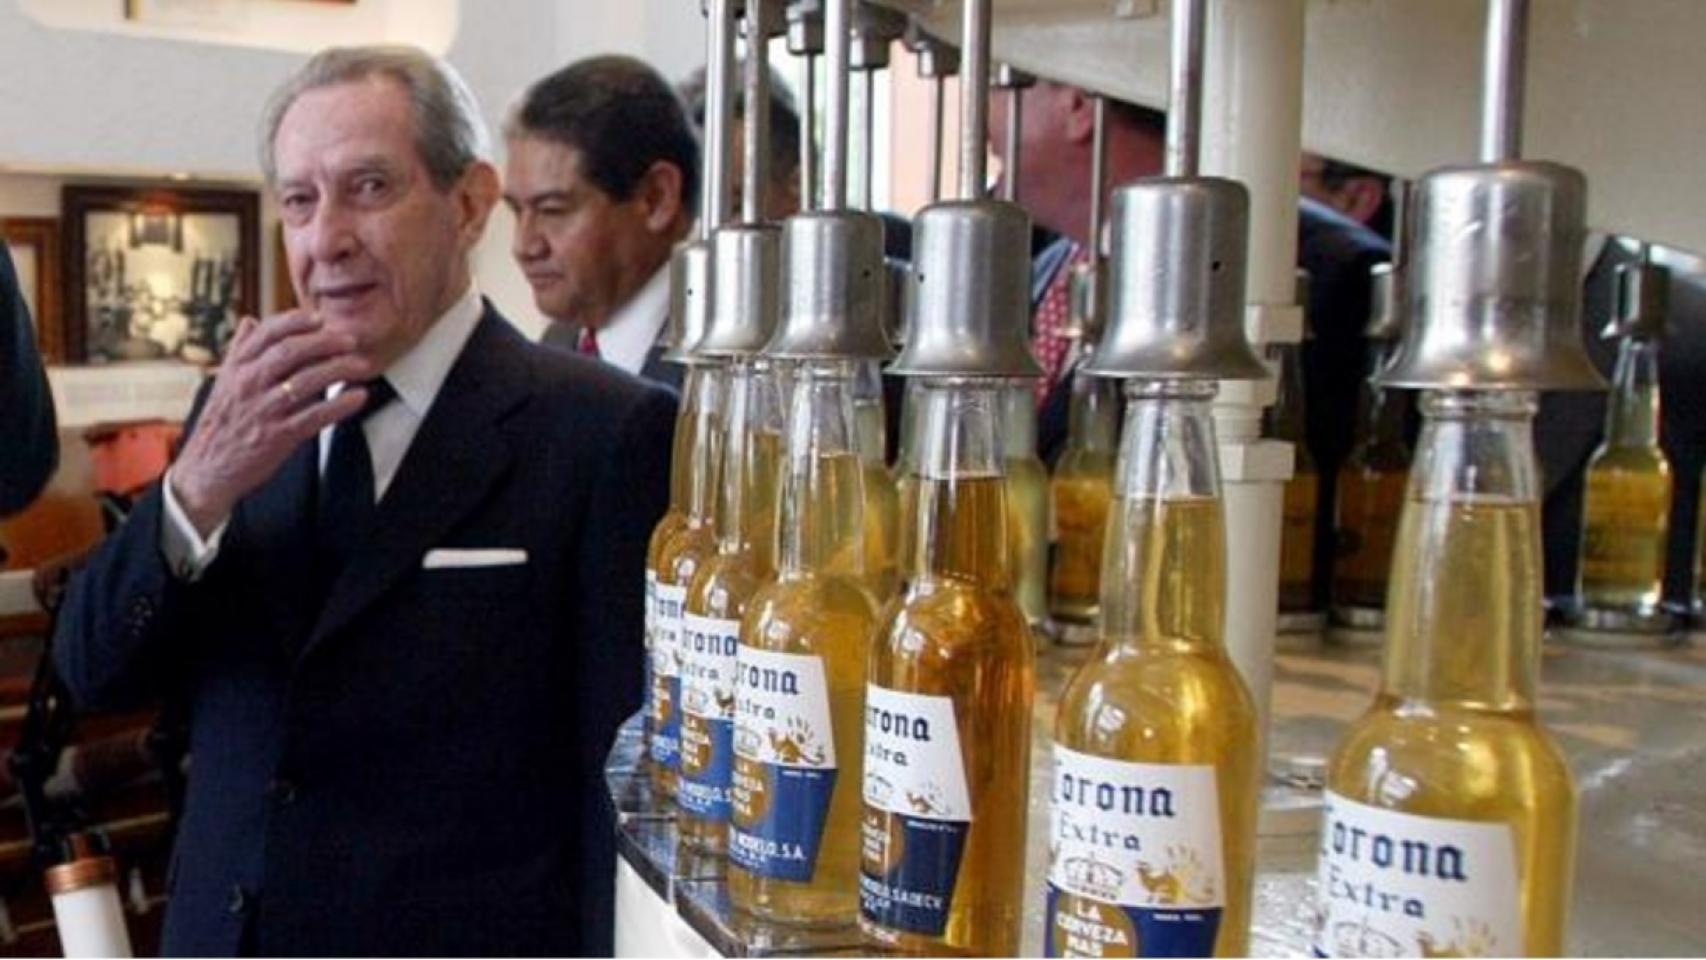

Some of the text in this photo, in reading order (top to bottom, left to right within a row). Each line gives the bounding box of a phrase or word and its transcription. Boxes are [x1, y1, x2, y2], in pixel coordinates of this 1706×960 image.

[735, 660, 800, 695] rona
[866, 706, 932, 742] rona
[1053, 762, 1177, 818] orona
[1060, 810, 1142, 851] Extra
[1323, 806, 1469, 883] orona
[1329, 864, 1425, 919] Extra
